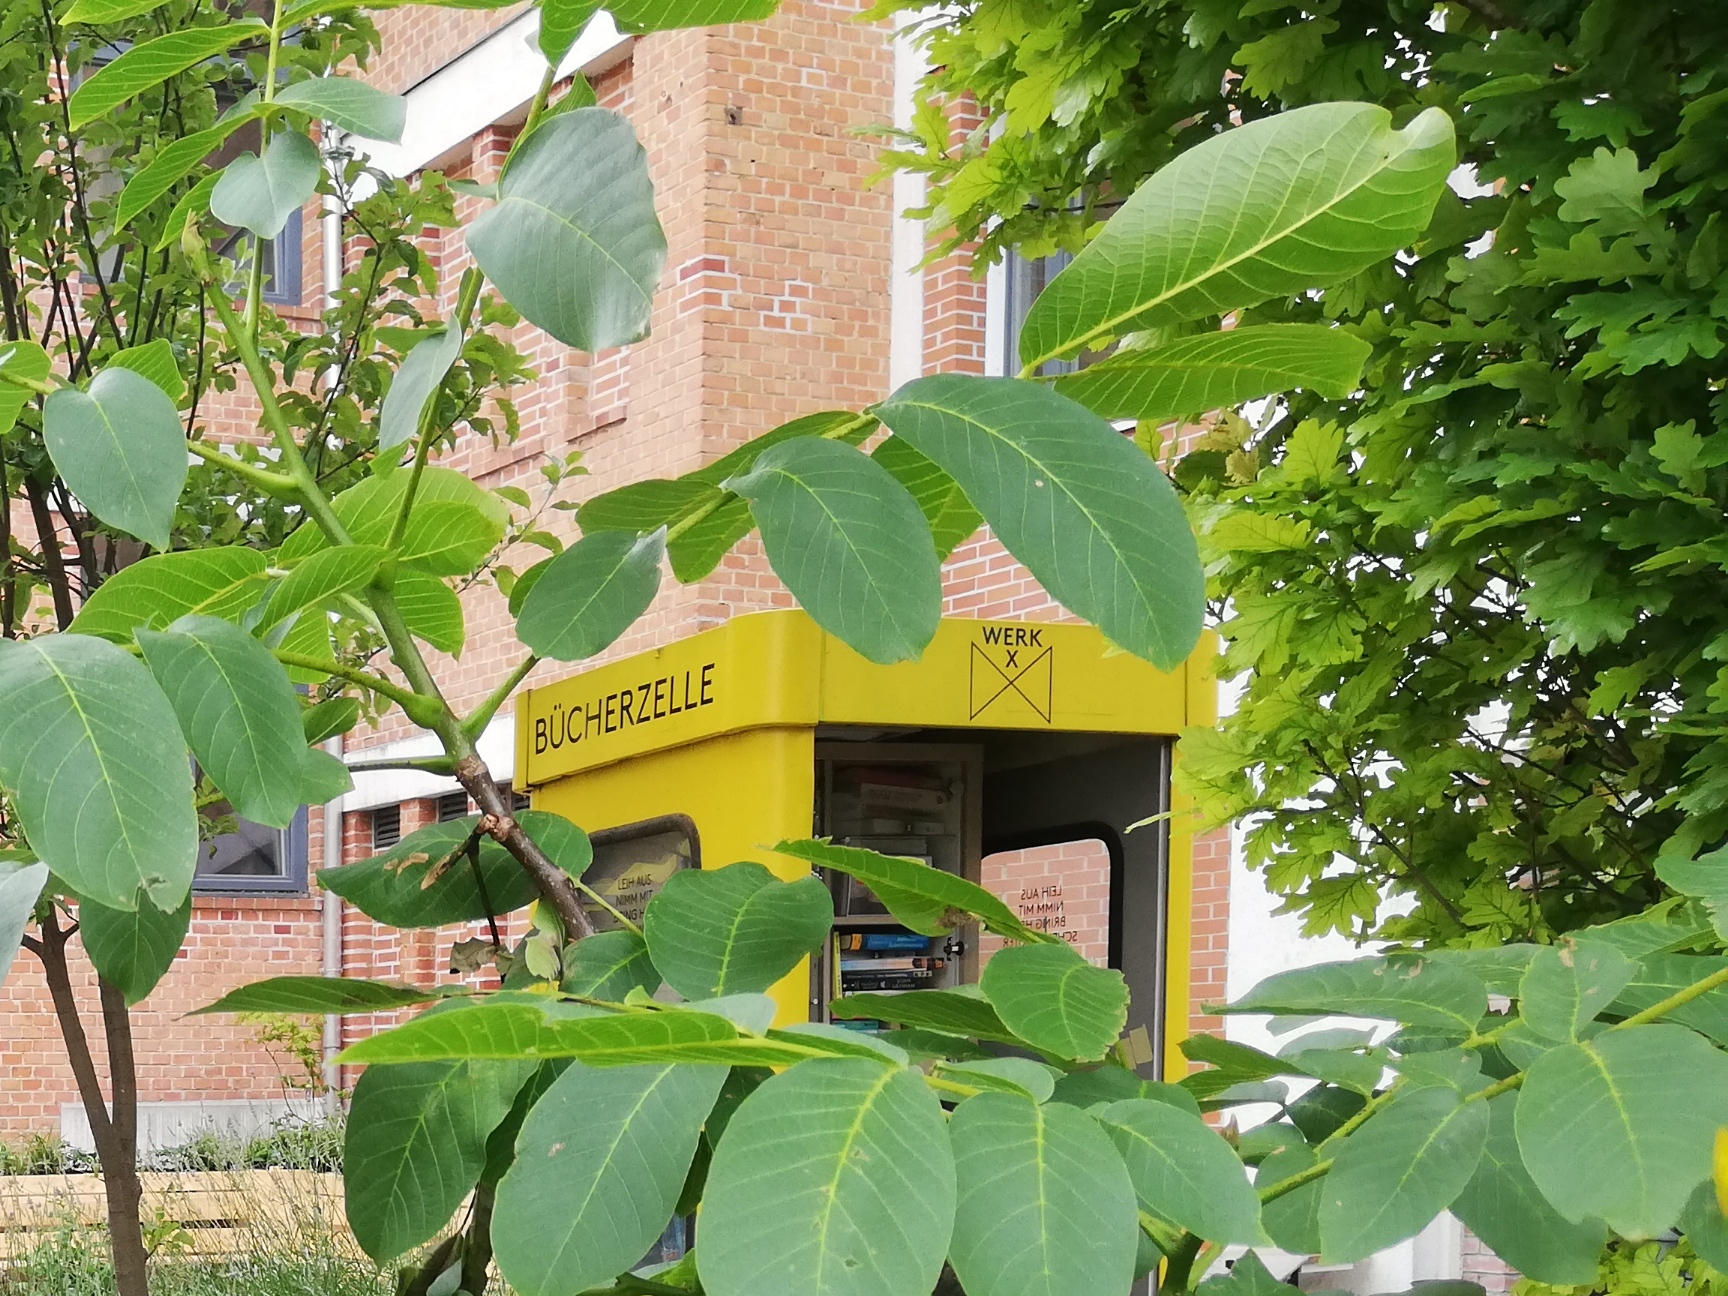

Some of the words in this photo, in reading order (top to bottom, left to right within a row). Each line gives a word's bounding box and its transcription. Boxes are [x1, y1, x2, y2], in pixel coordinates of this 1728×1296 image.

[982, 626, 1043, 647] WERK
[1005, 649, 1018, 668] X
[535, 663, 715, 755] BÜCHERZELLE
[636, 874, 652, 887] AUS
